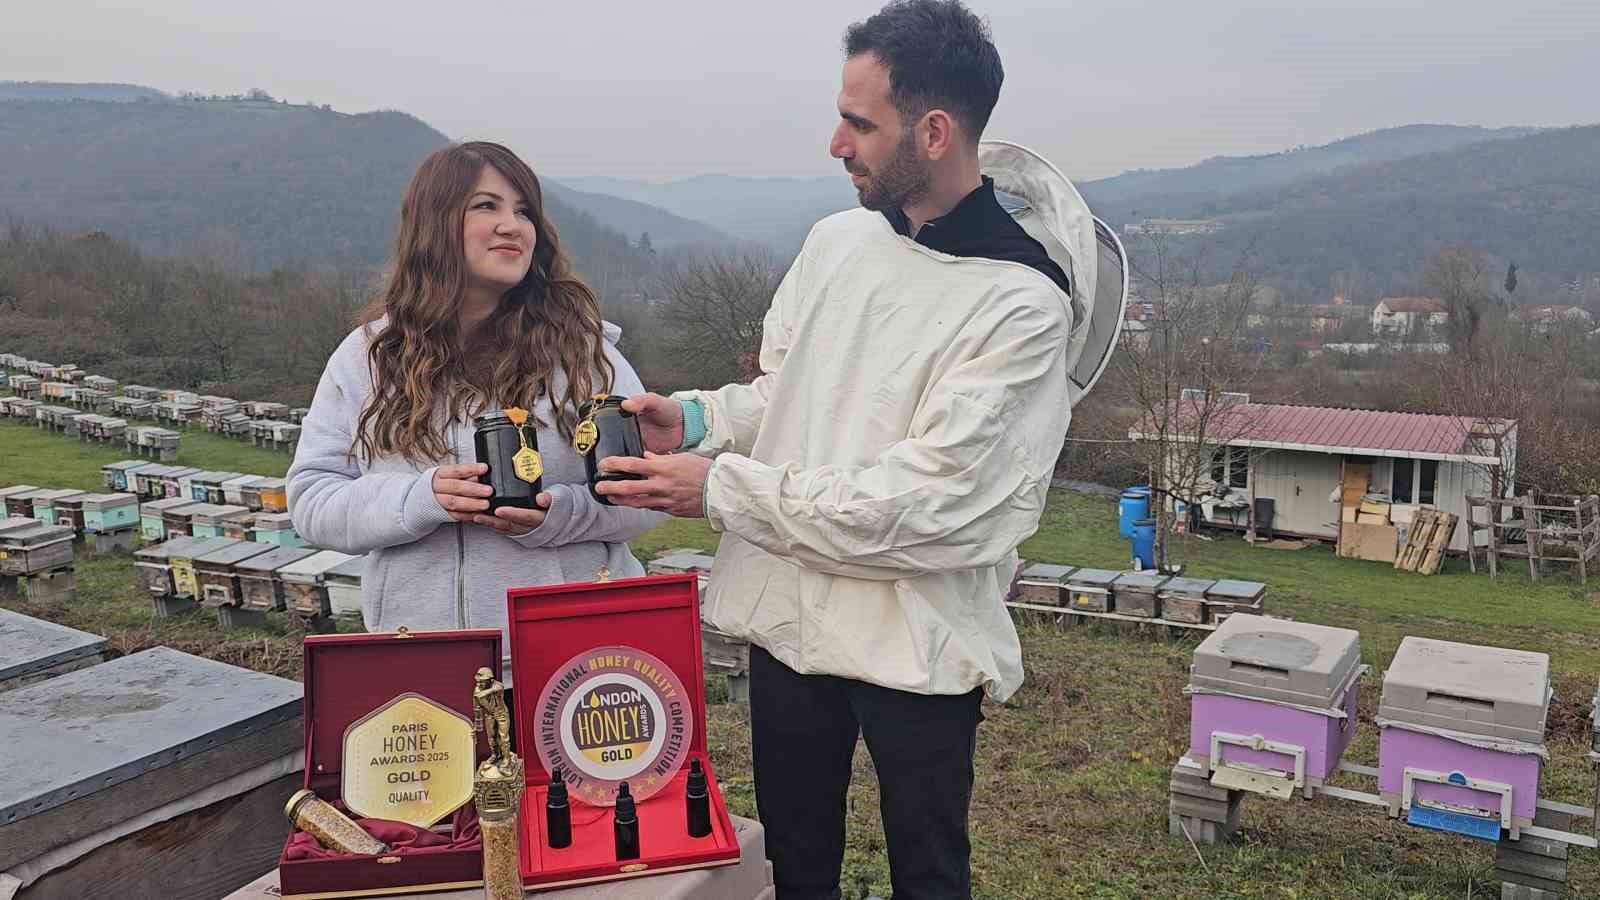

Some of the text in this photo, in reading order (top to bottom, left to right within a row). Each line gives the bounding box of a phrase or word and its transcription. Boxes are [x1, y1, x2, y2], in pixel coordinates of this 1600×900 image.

[588, 655, 631, 671] HONEY
[633, 659, 676, 699] QUALITY
[543, 664, 588, 747] INTERNATIONAL
[392, 722, 428, 734] PARIS
[577, 705, 639, 745] HONEY
[639, 704, 651, 738] AWARDS
[383, 734, 438, 753] HONEY
[654, 702, 684, 777] COMPETITION
[370, 751, 449, 767] AWARDS 2025
[601, 748, 633, 762] GOLD
[387, 769, 431, 784] GOLD
[388, 790, 430, 804] QUALITY
